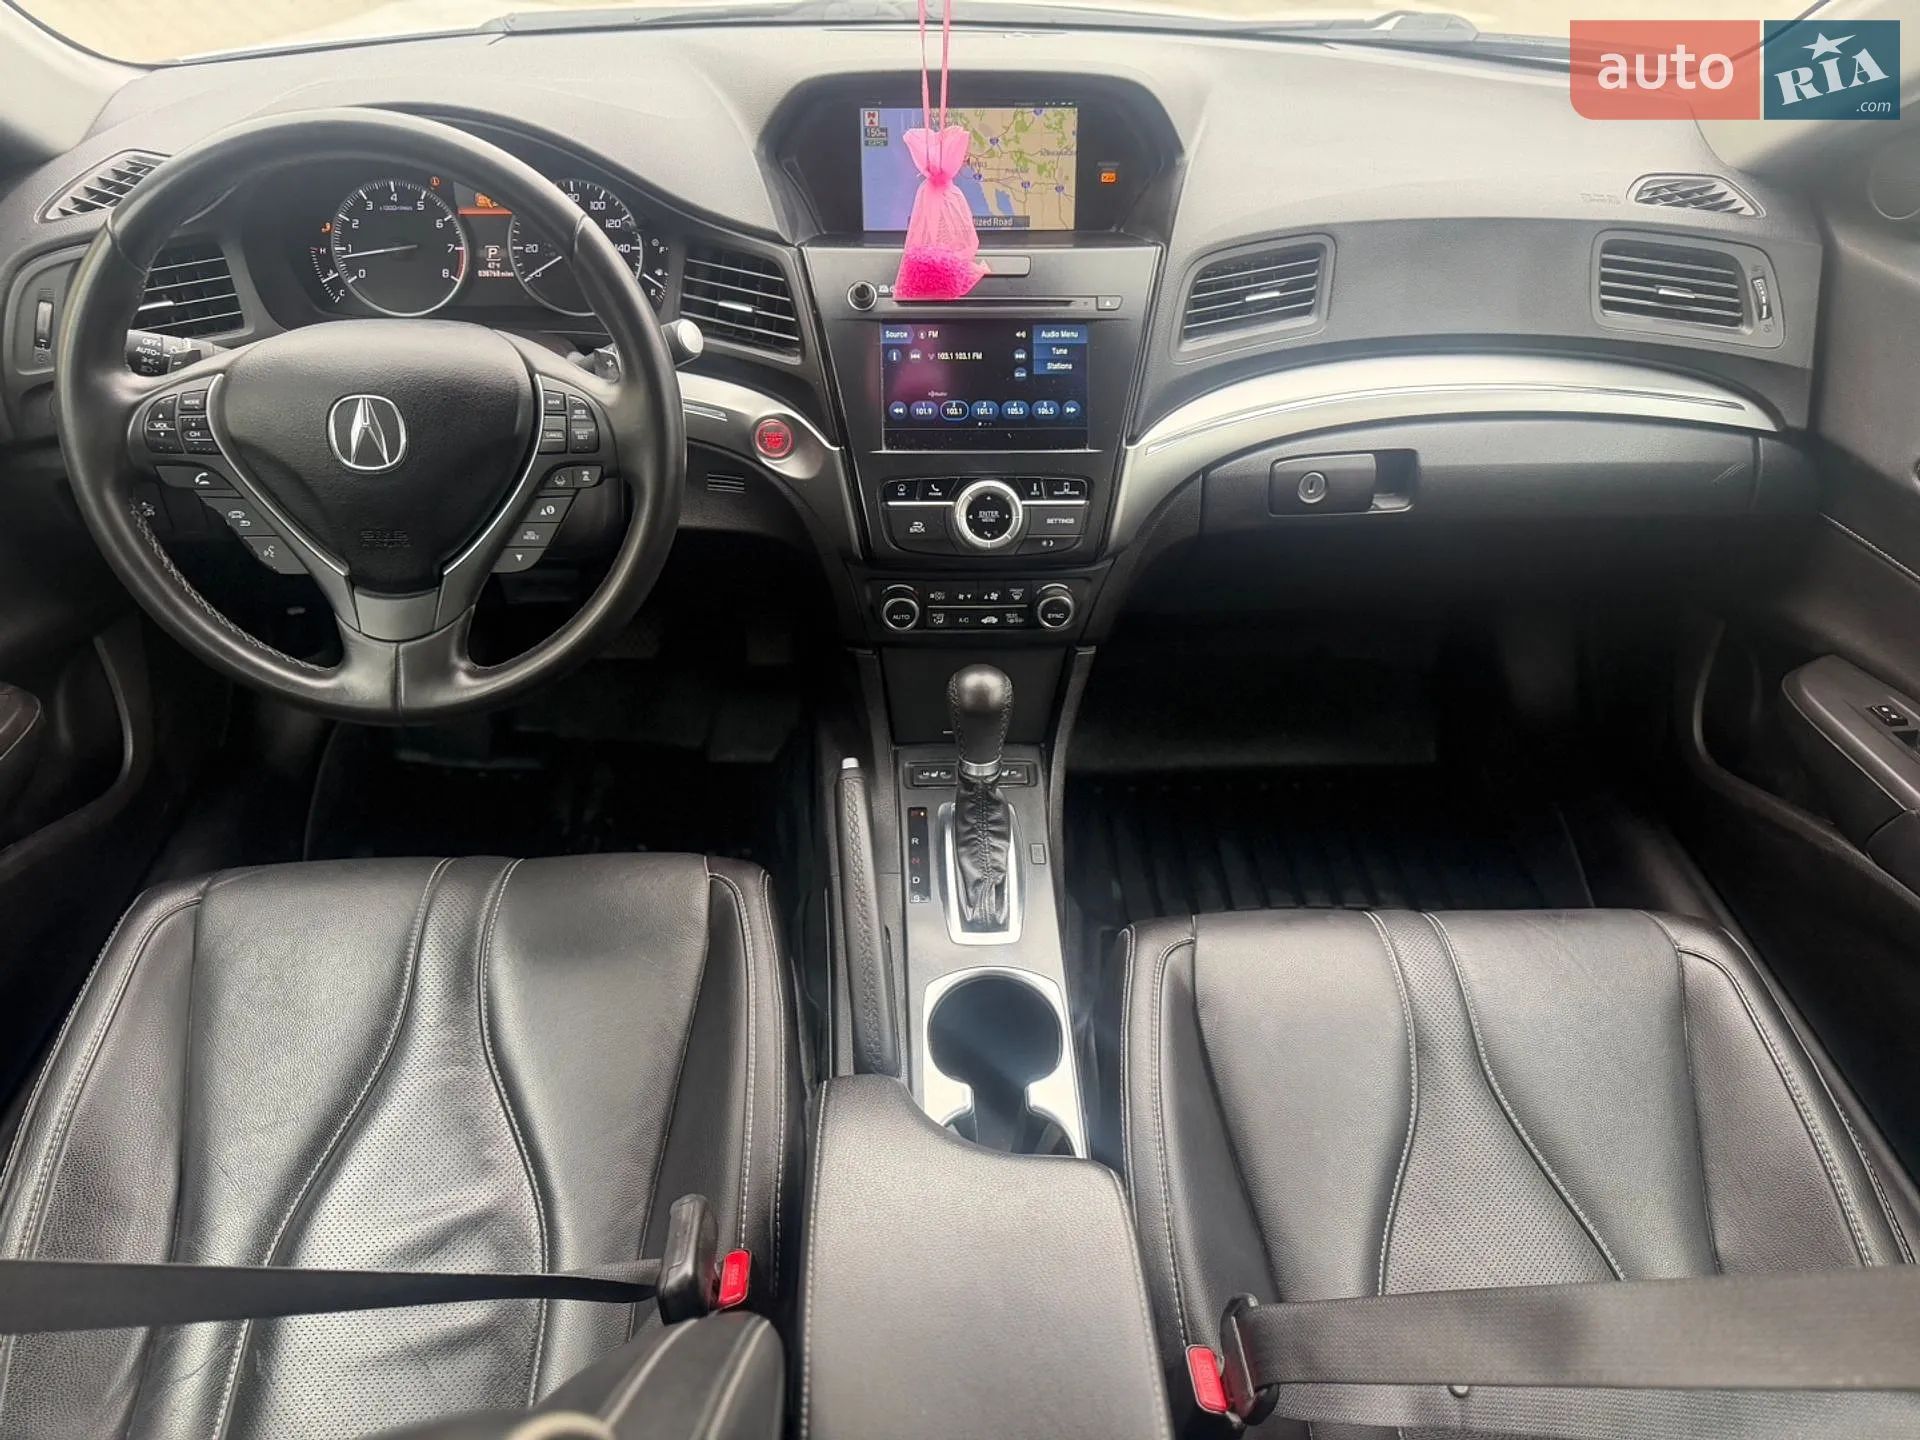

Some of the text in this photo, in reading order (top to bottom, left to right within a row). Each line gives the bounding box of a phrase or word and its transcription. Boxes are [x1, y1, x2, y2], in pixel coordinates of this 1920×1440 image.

[390, 193, 398, 202] 4
[366, 202, 374, 211] 3
[417, 202, 425, 211] 5
[590, 201, 606, 211] 100
[352, 219, 360, 228] 2
[436, 219, 444, 228] 6
[605, 219, 622, 228] 120
[993, 217, 1013, 226] Road
[348, 244, 352, 253] 1
[447, 244, 454, 253] 7
[488, 248, 497, 258] P
[525, 244, 539, 253] 20
[358, 270, 366, 279] 0
[442, 269, 449, 278] 8
[885, 330, 908, 339] Source
[1041, 330, 1079, 338] Audio Menu
[136, 346, 157, 356] AUTO
[1052, 347, 1068, 355] Tune
[937, 352, 983, 360] 103.1 103.1 FM
[1047, 362, 1073, 370] Stations
[946, 407, 963, 415] 103.1
[976, 407, 993, 415] 101.1
